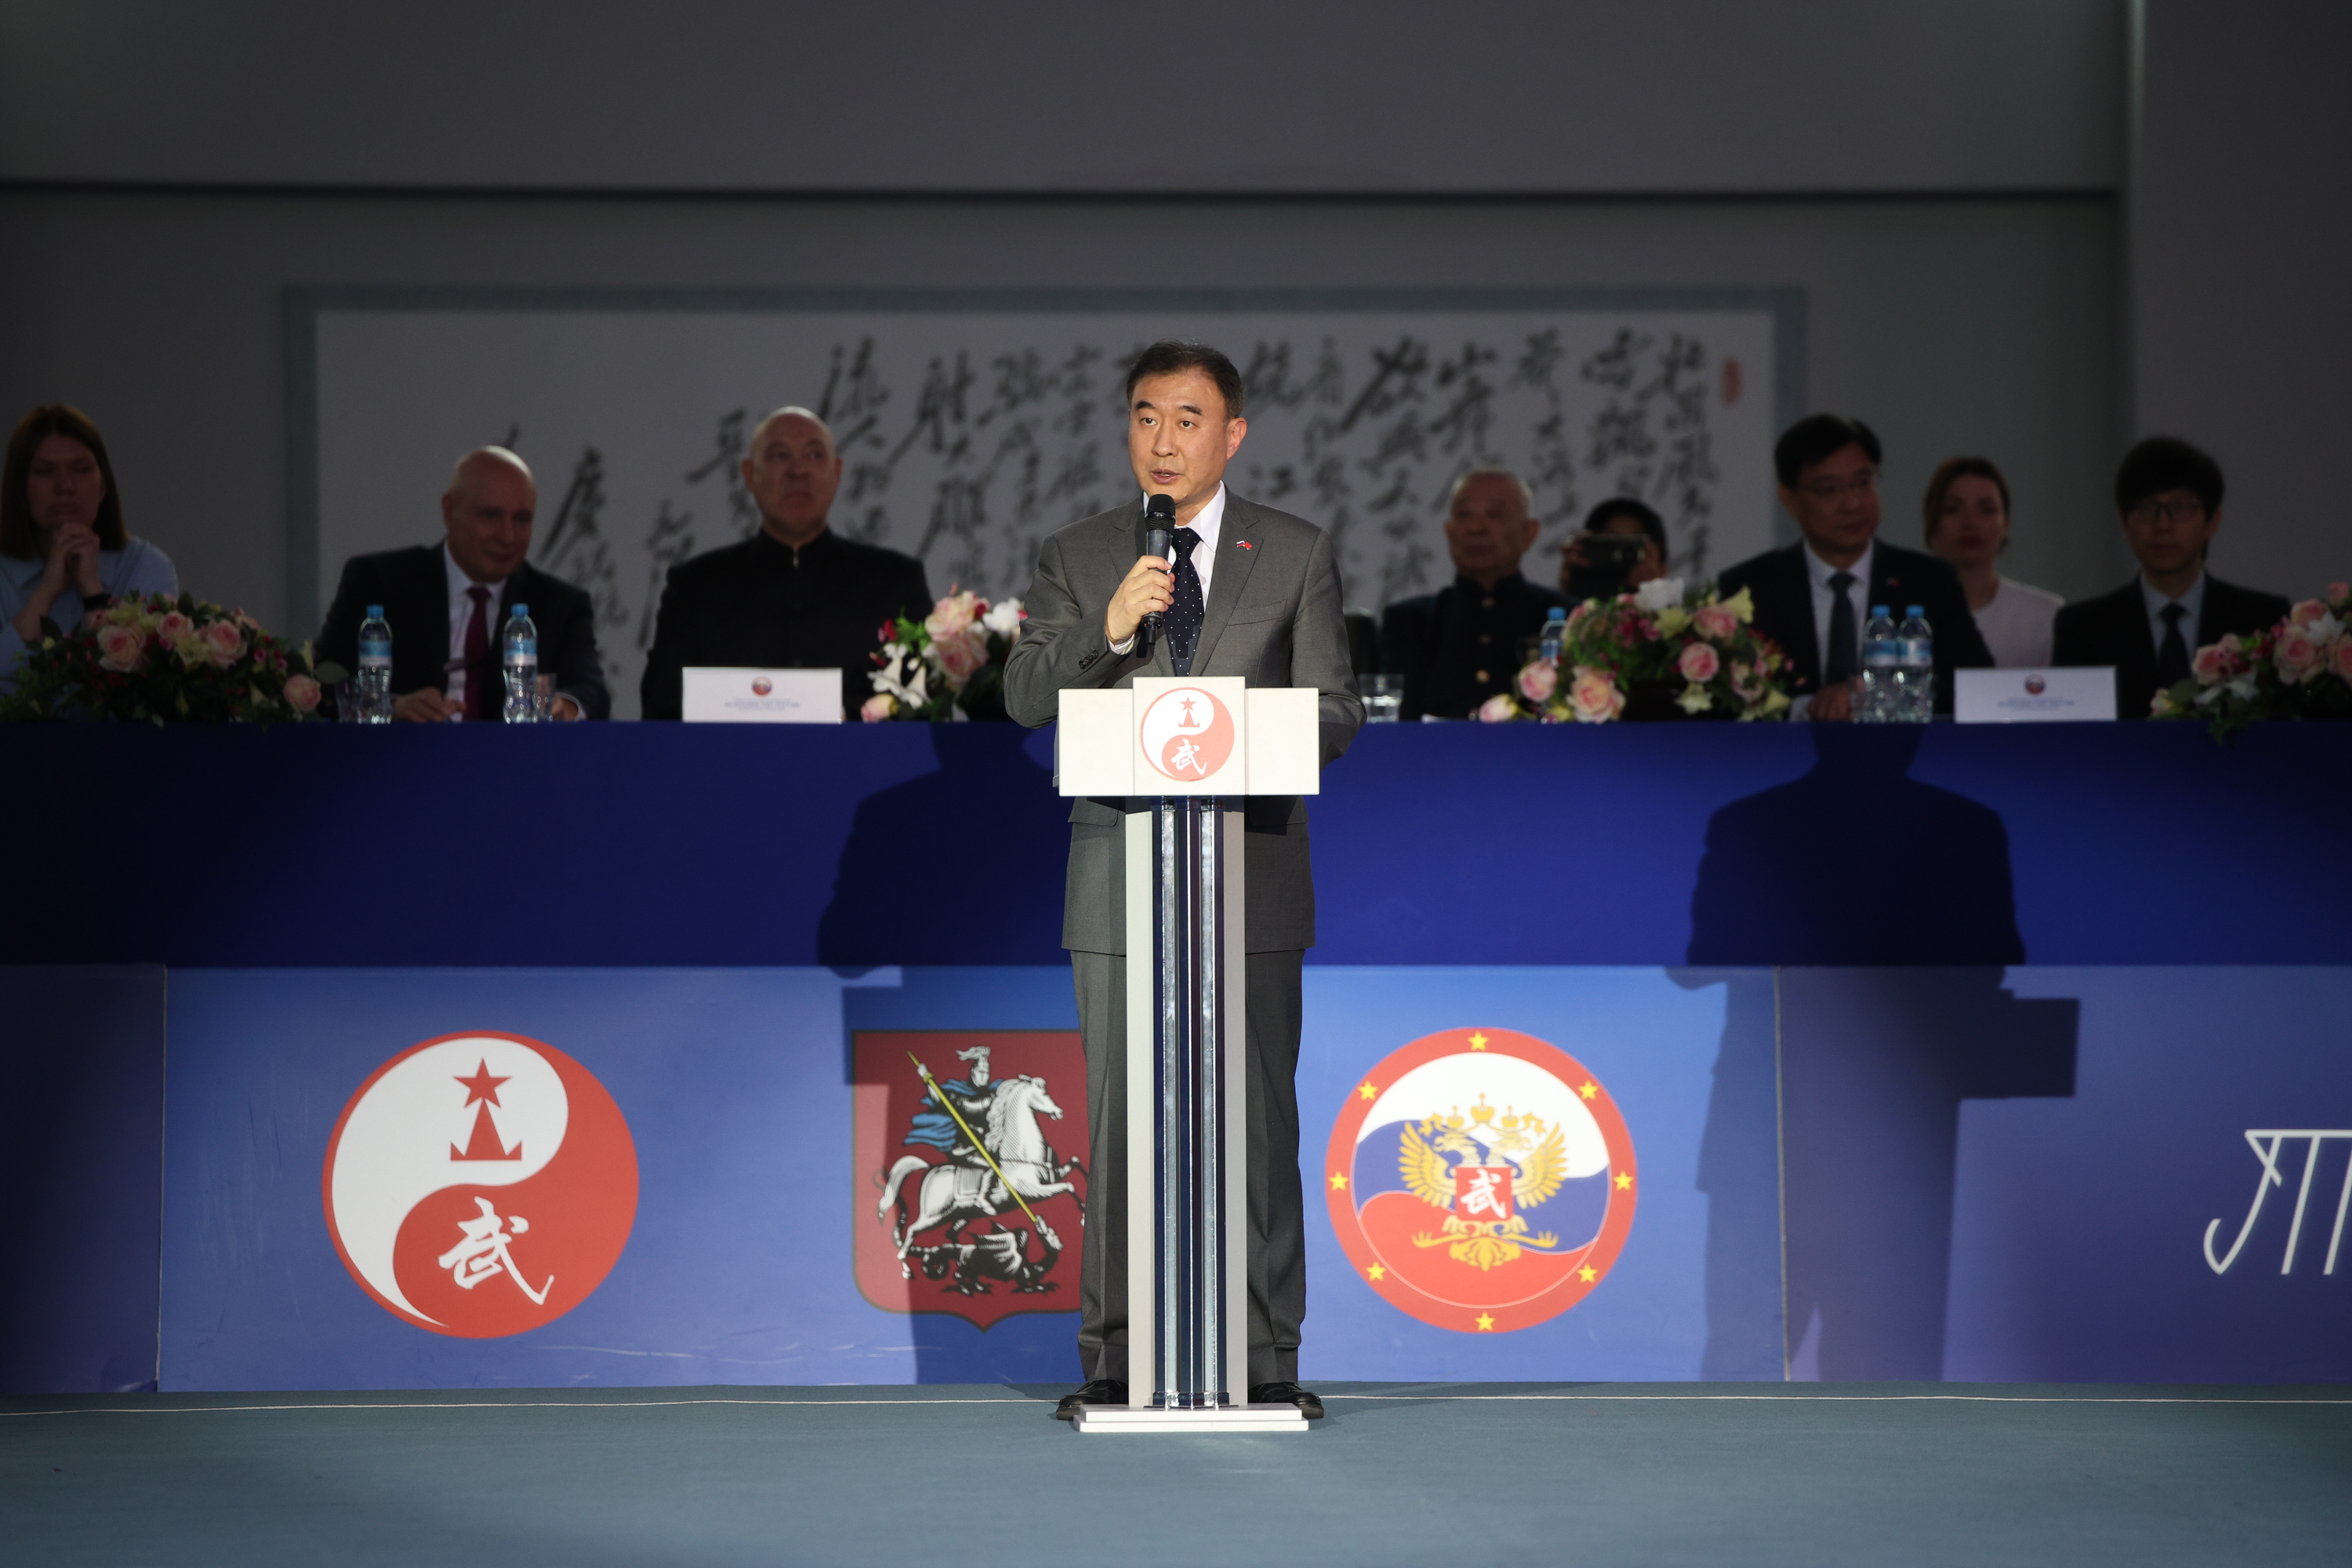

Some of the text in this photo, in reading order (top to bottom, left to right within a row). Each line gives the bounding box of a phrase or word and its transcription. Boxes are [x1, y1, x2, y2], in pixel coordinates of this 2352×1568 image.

[1171, 738, 1207, 775] 武
[1460, 1168, 1508, 1220] 武
[437, 1196, 555, 1305] 武
